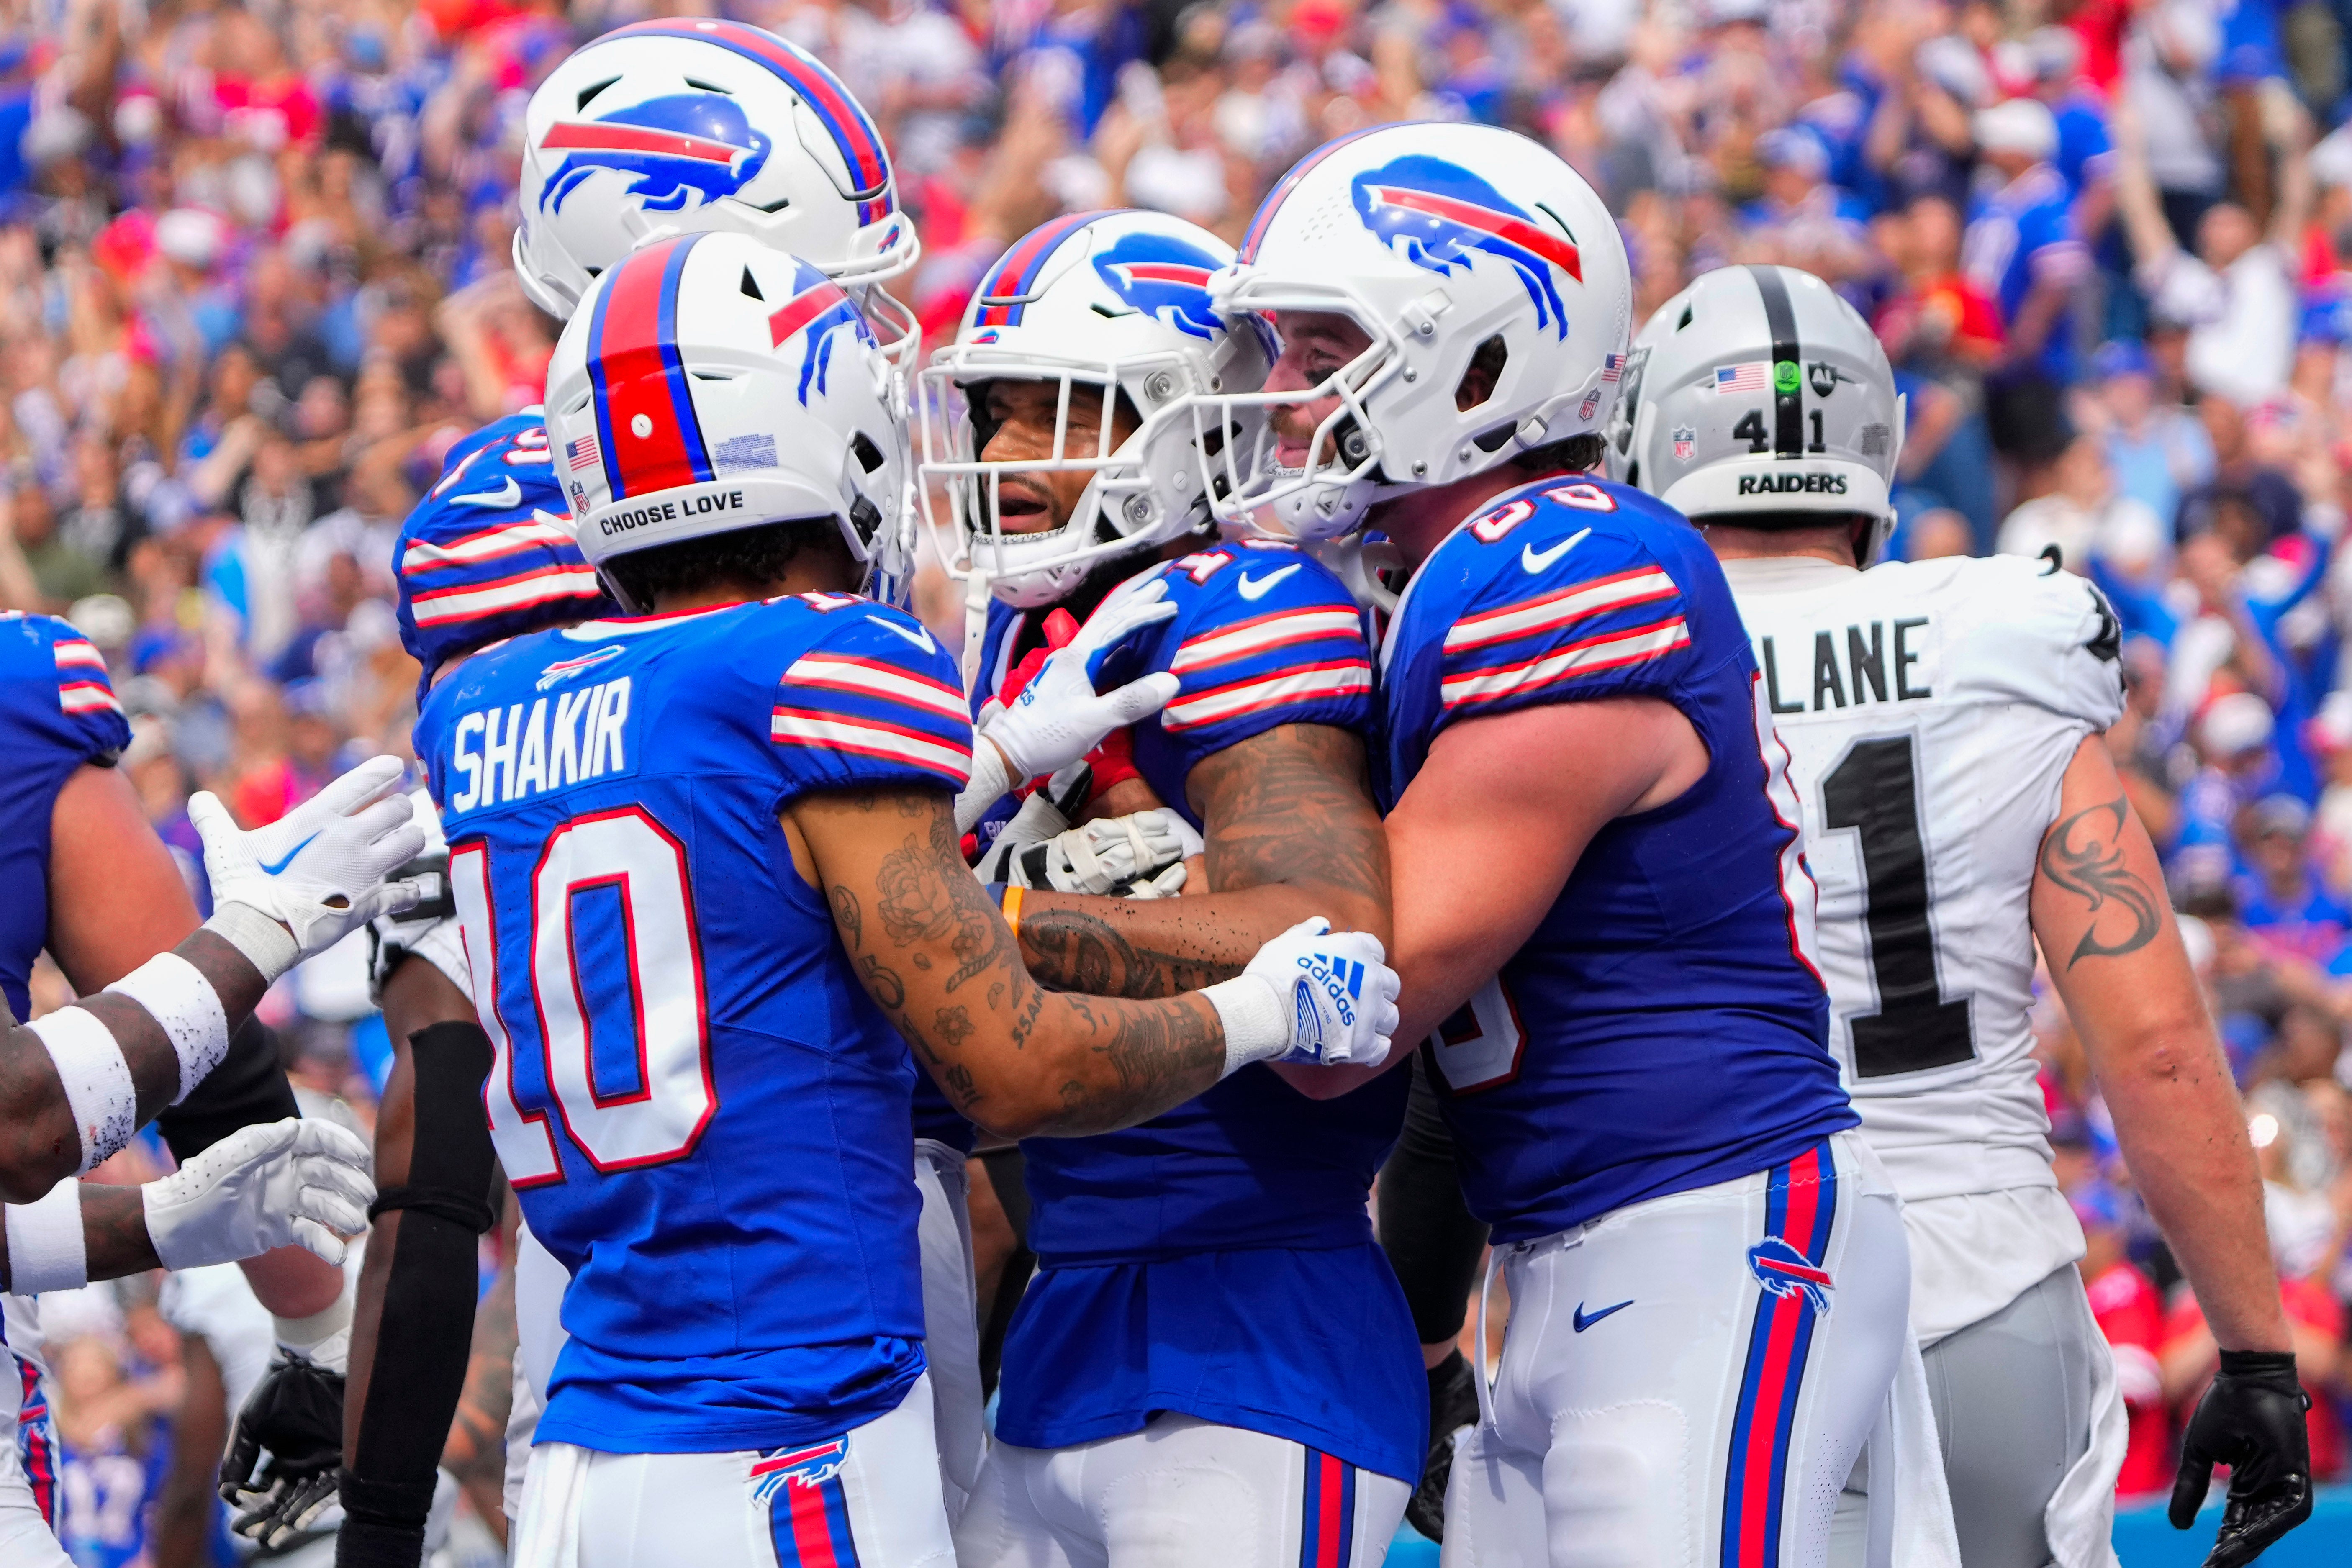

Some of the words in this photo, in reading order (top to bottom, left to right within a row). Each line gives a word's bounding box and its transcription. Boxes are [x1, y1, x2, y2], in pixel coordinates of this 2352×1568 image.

[1811, 367, 1835, 385] AL
[1580, 400, 1595, 418] NFL
[1675, 441, 1693, 456] NFL
[1738, 472, 1848, 495] RAIDERS
[600, 502, 676, 536] CHOOSE
[681, 490, 743, 516] LOVE
[1763, 615, 1933, 714] LANE
[453, 676, 631, 814] SHAKIR
[449, 801, 721, 1193] 10
[1297, 953, 1356, 1027] adidas
